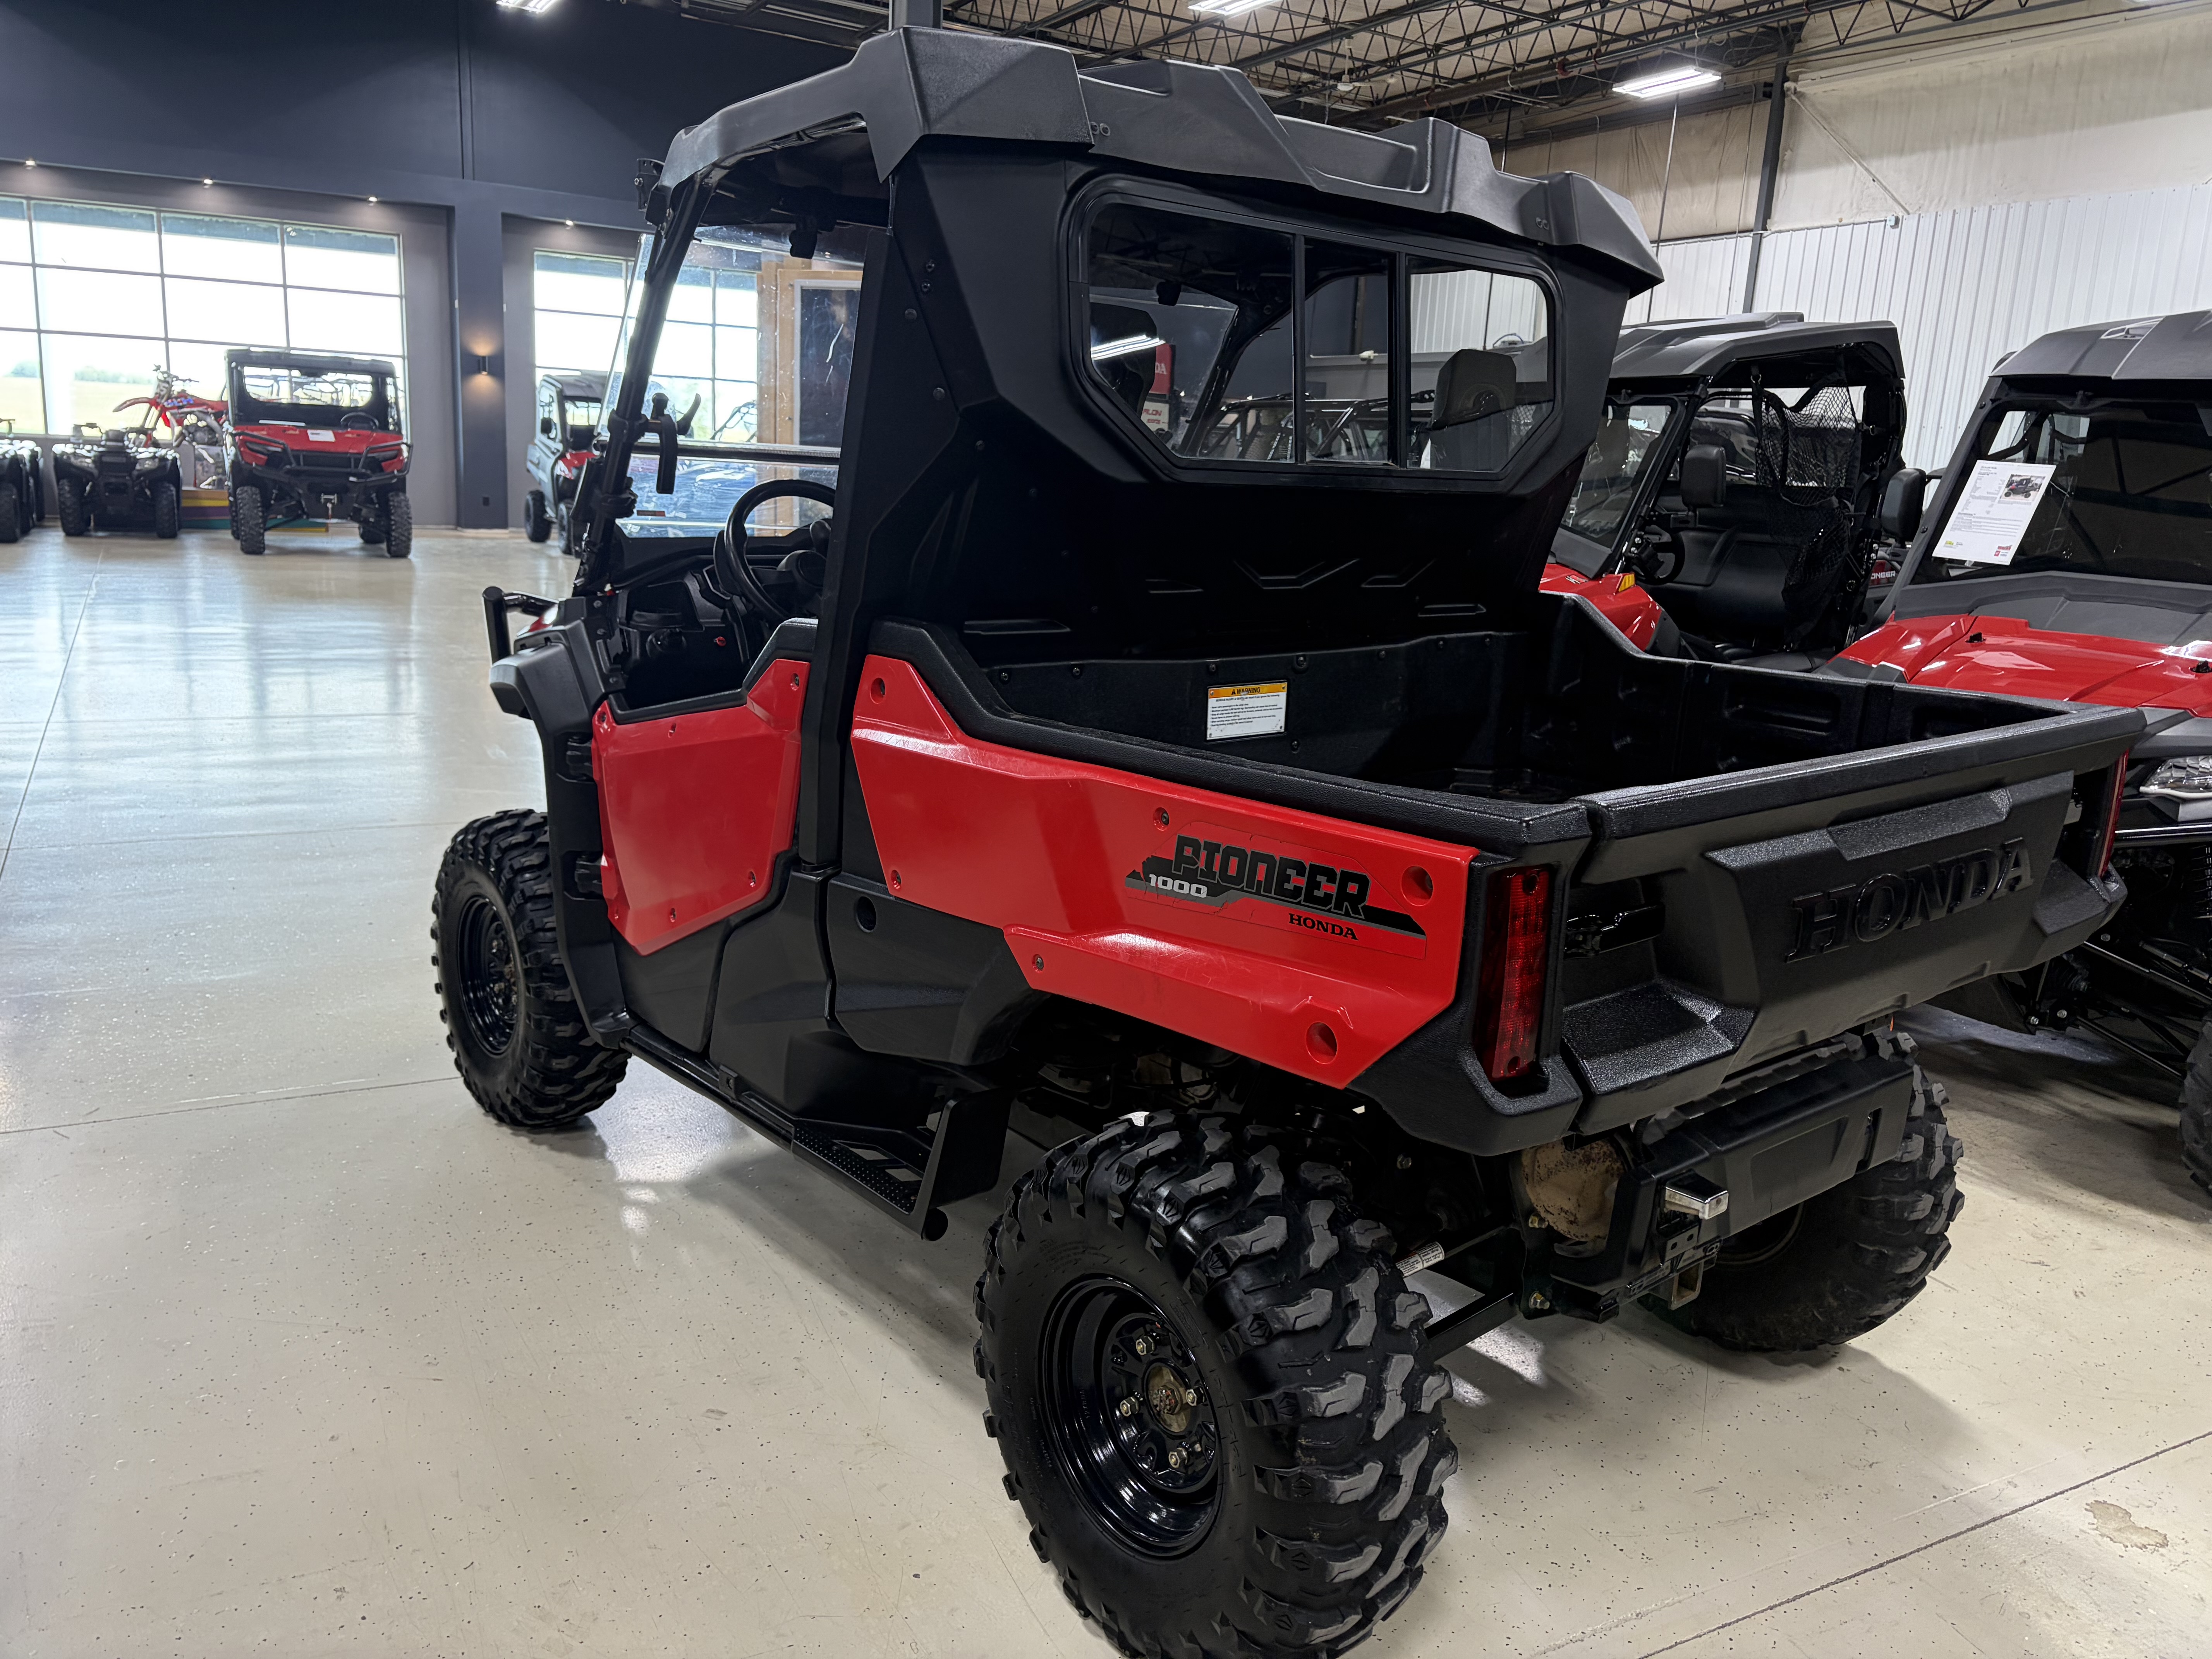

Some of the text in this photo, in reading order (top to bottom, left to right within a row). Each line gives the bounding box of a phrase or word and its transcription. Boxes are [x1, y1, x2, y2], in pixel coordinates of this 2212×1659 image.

[1870, 571, 1896, 579] ONEER
[1149, 874, 1207, 898] 1000
[1172, 834, 1371, 919] PIONEER
[1784, 837, 2034, 963] HONDA
[1288, 913, 1358, 940] HONDA
